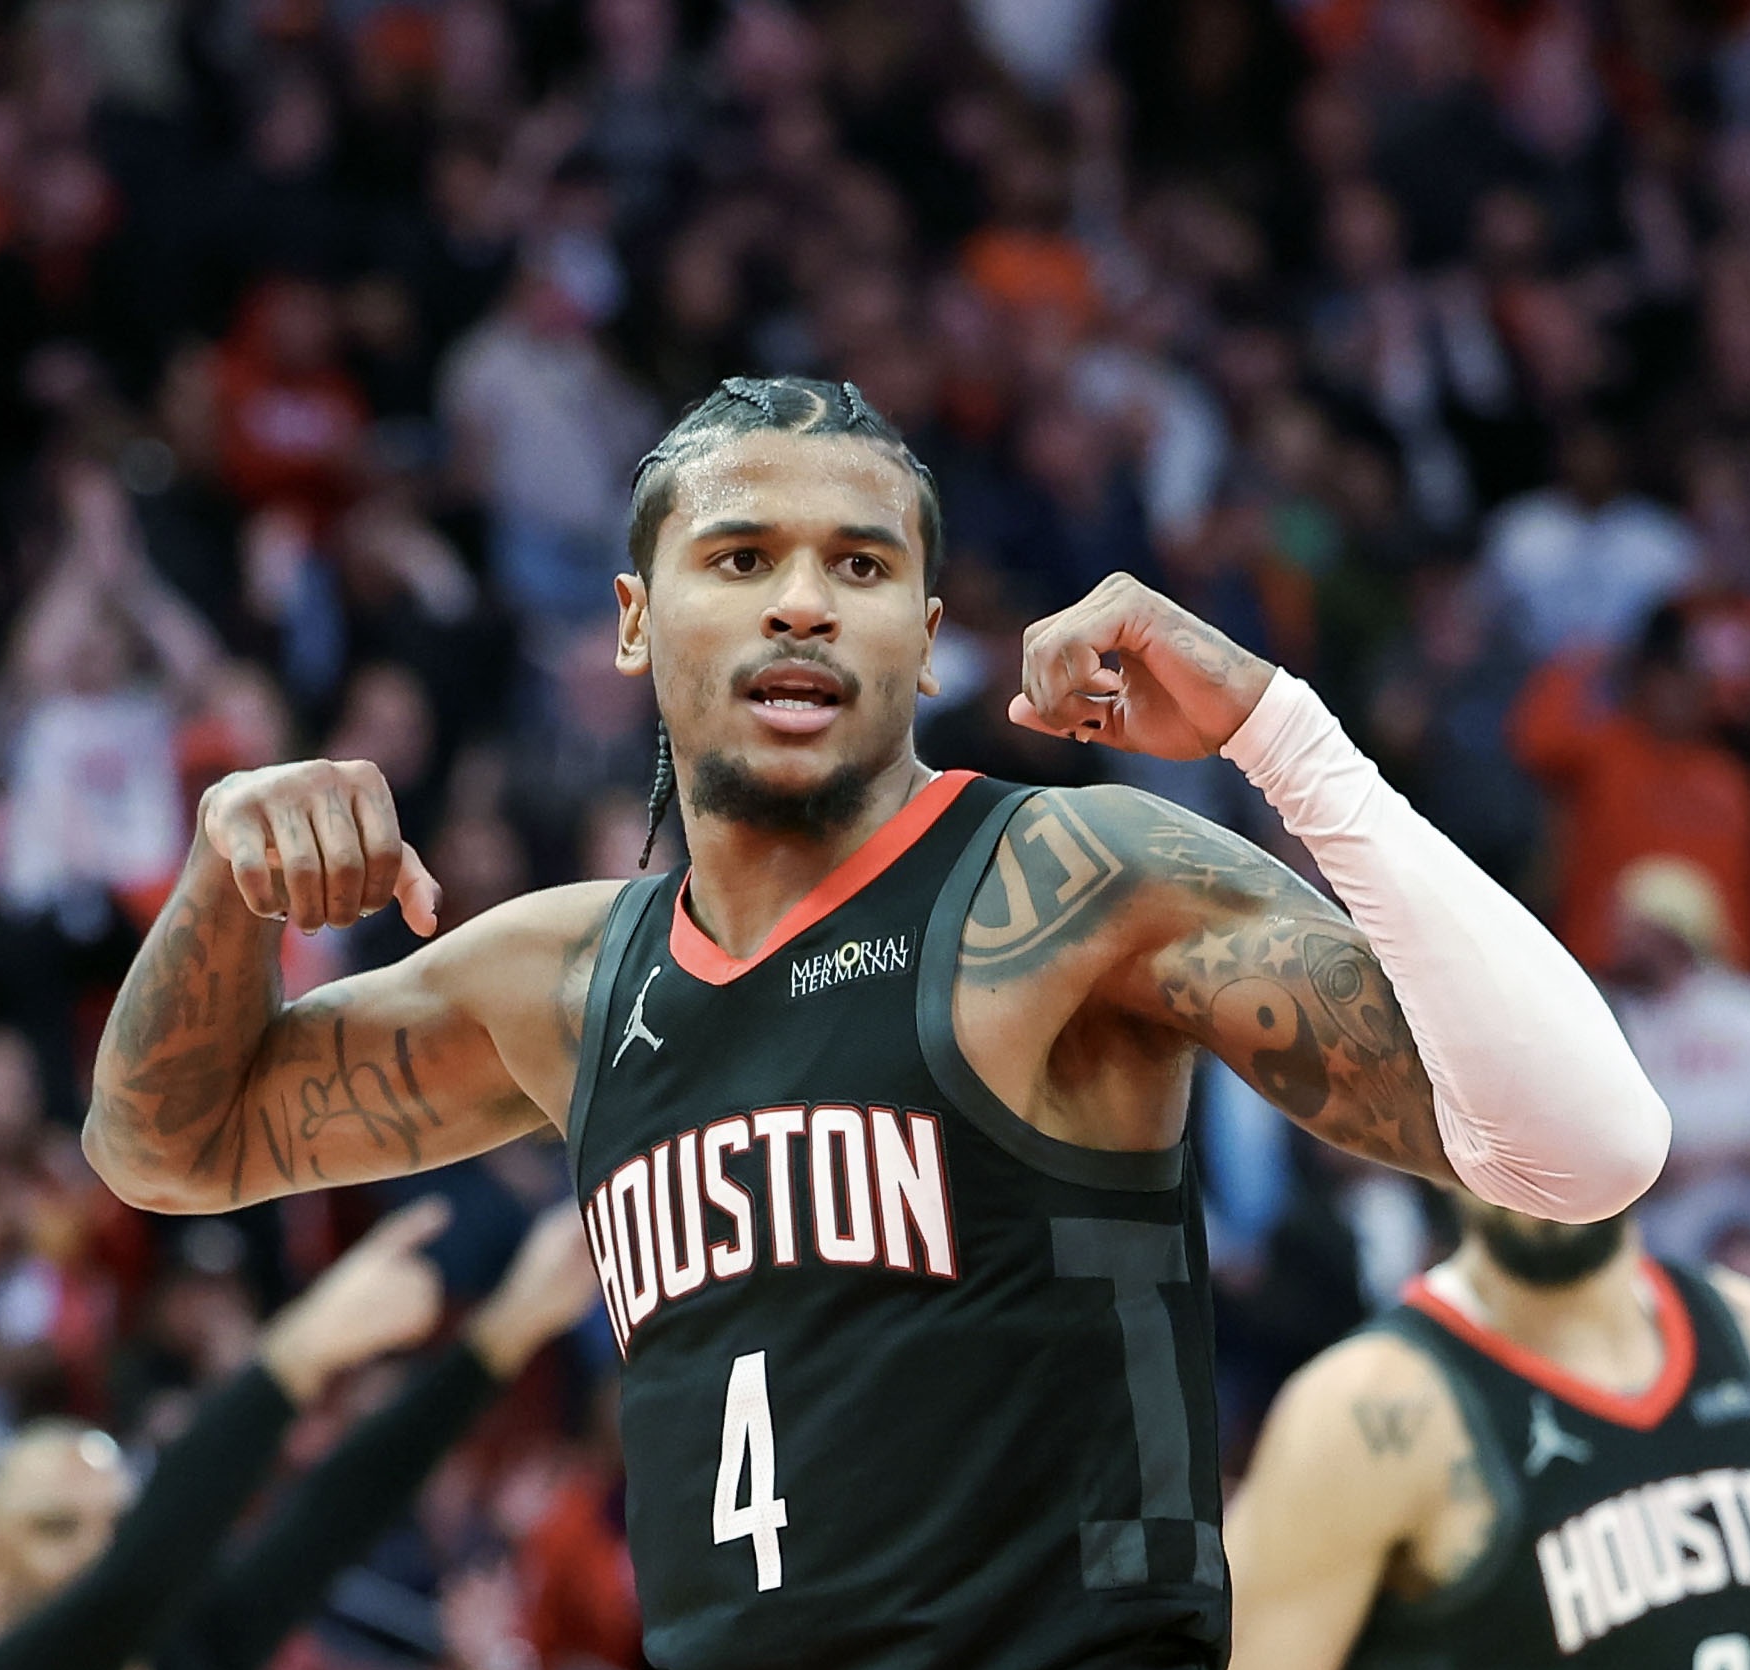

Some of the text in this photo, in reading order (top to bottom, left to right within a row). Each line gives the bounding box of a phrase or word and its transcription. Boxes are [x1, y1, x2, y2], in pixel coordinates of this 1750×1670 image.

[791, 935, 909, 979] MEMORIAL
[791, 951, 907, 997] HERMANN
[584, 1104, 958, 1363] HOUSTON
[712, 1350, 787, 1592] 4
